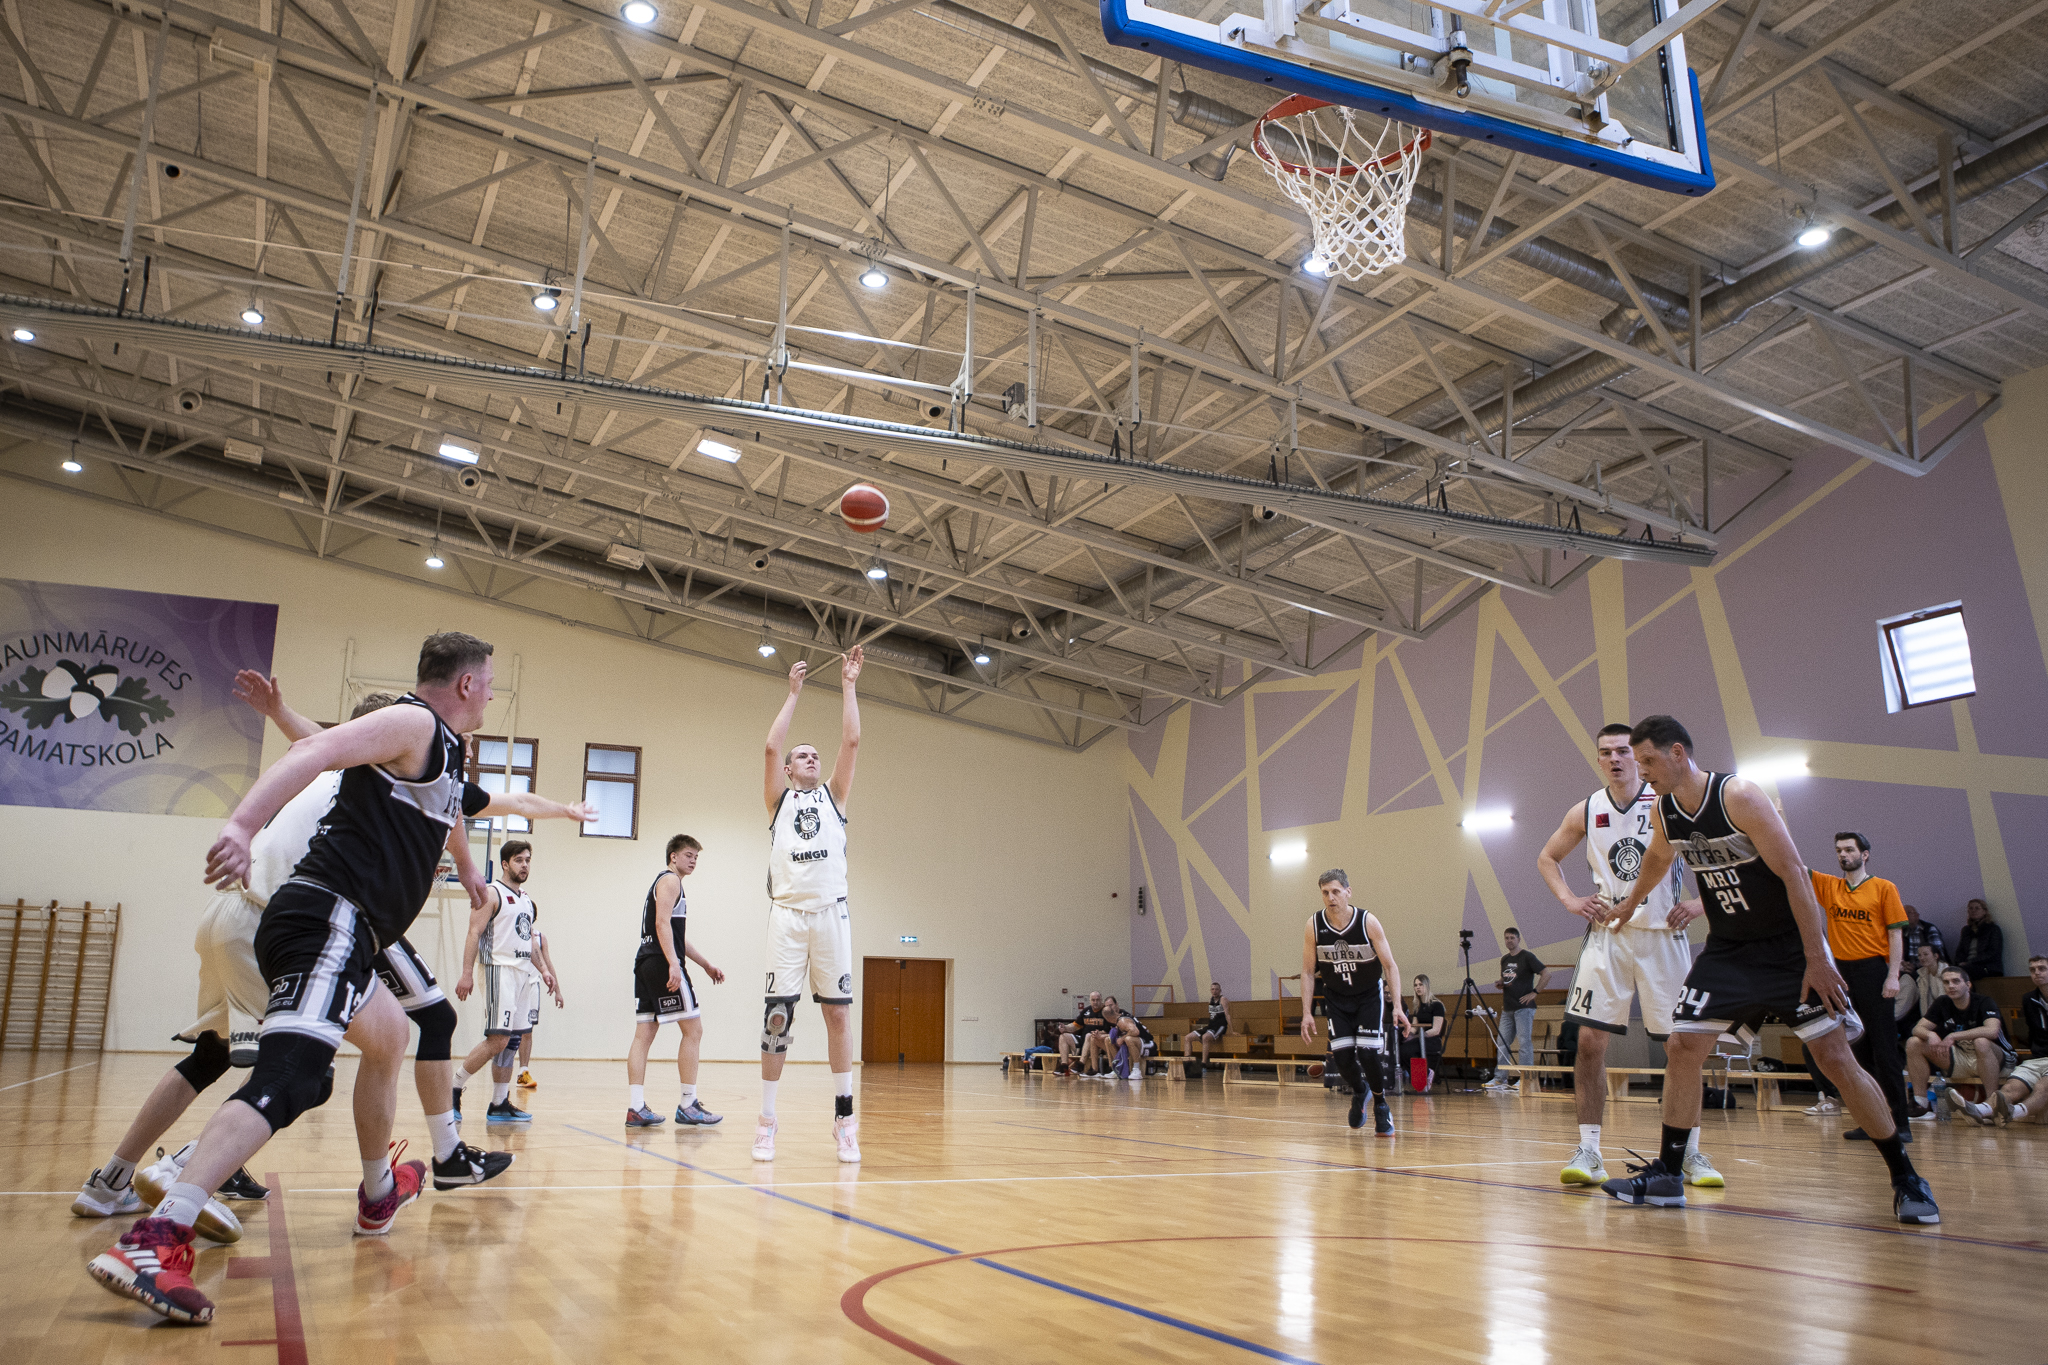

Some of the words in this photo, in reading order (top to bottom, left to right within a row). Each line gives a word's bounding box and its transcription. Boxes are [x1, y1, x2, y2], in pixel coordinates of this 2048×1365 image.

[0, 630, 192, 691] AUNMĀRUPES
[792, 850, 828, 862] KINGU
[1682, 847, 1741, 866] KURSA
[1702, 869, 1741, 889] MRU
[1715, 887, 1750, 914] 24
[1837, 908, 1872, 922] MNBL
[1323, 950, 1363, 960] KURSA
[1334, 962, 1357, 973] MRU
[1342, 972, 1352, 985] 4
[1571, 987, 1593, 1015] 24
[504, 1010, 511, 1027] 3
